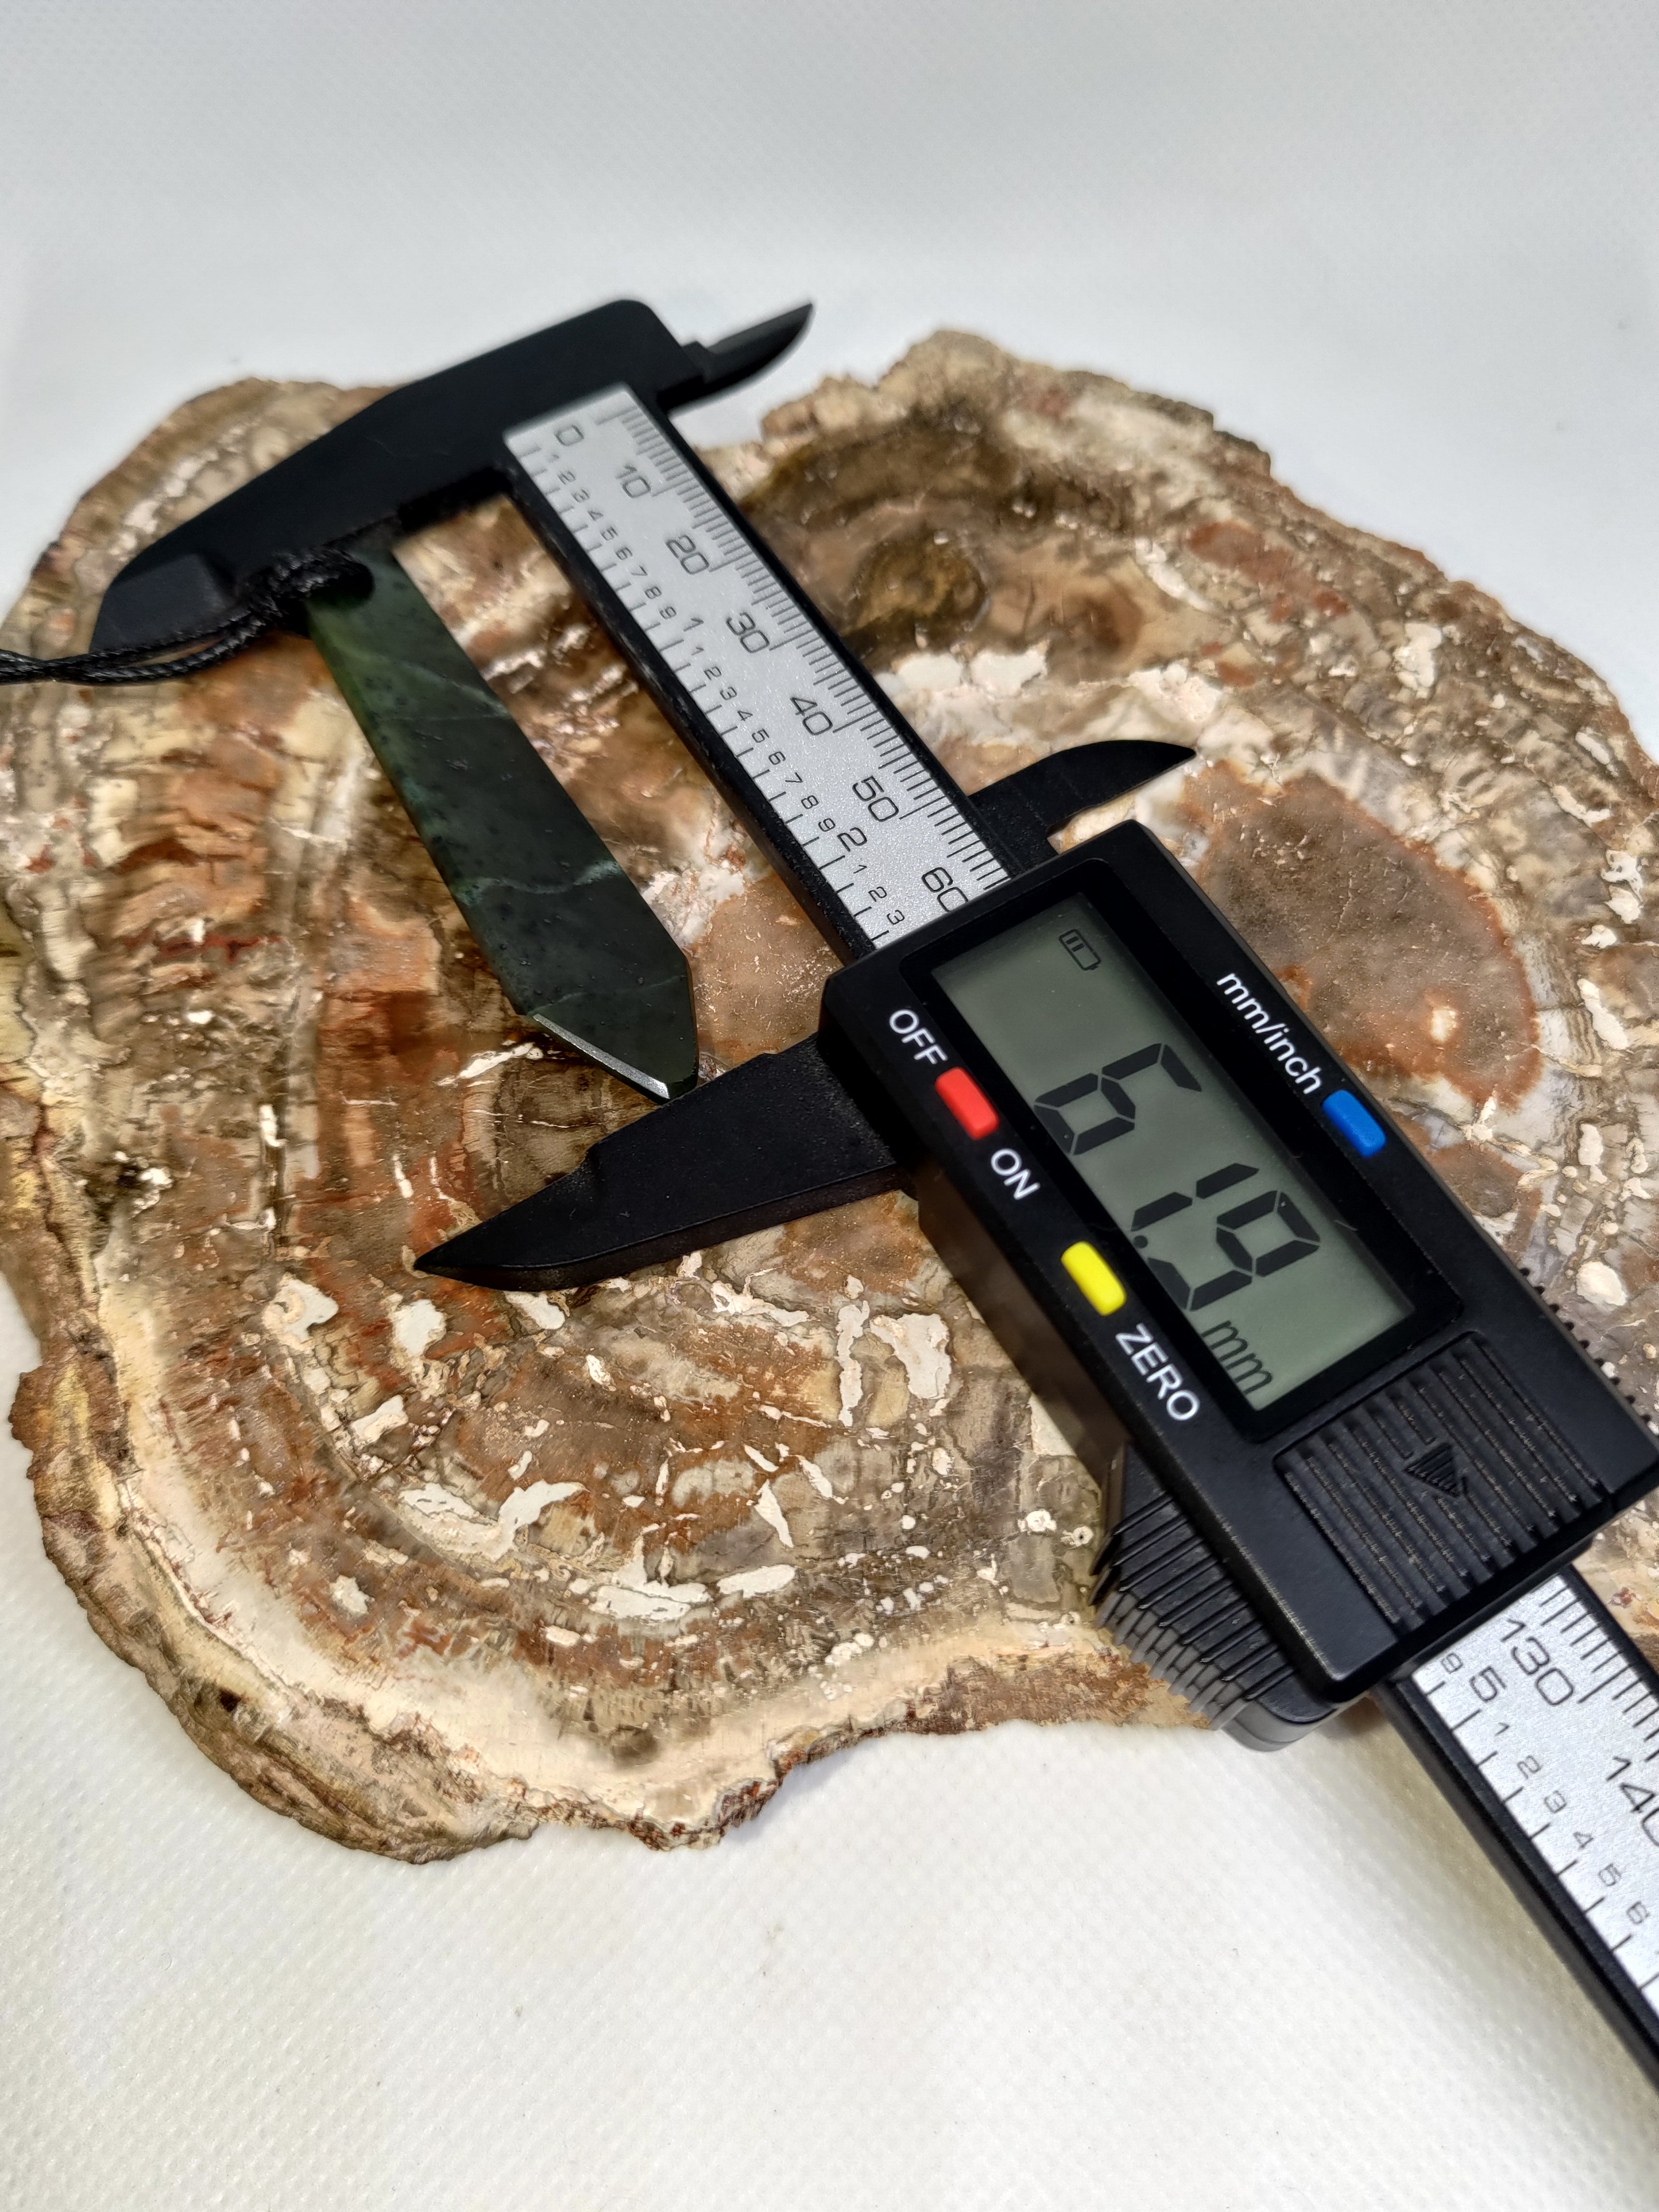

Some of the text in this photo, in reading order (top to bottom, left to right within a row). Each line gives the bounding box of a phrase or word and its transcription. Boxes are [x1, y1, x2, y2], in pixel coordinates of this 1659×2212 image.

[554, 424, 583, 446] 0
[615, 465, 651, 498] 10
[601, 526, 618, 541] 5
[615, 546, 633, 561] 6
[666, 534, 709, 575] 20
[630, 566, 648, 577] 7
[644, 585, 662, 599] 8
[659, 606, 677, 620] 9
[683, 617, 704, 632] 1
[726, 612, 770, 653] 30
[691, 646, 704, 656] 1
[703, 666, 722, 681] 2
[719, 686, 738, 701] 3
[737, 710, 753, 722] 4
[790, 696, 833, 735] 40
[752, 728, 770, 743] 5
[768, 751, 786, 766] 6
[785, 772, 803, 784] 7
[800, 795, 819, 810] 8
[852, 775, 899, 822] 50
[818, 817, 836, 832] 9
[837, 827, 868, 852] 2
[853, 864, 867, 874] 1
[868, 886, 888, 902] 2
[921, 867, 969, 912] 60
[887, 909, 905, 925] 3
[888, 1009, 947, 1065] OFF
[1216, 973, 1322, 1095] mm/inch
[990, 1148, 1041, 1200] ON
[1201, 1320, 1274, 1394] mm
[1115, 1323, 1201, 1421] ZERO
[1500, 1618, 1574, 1705] 130
